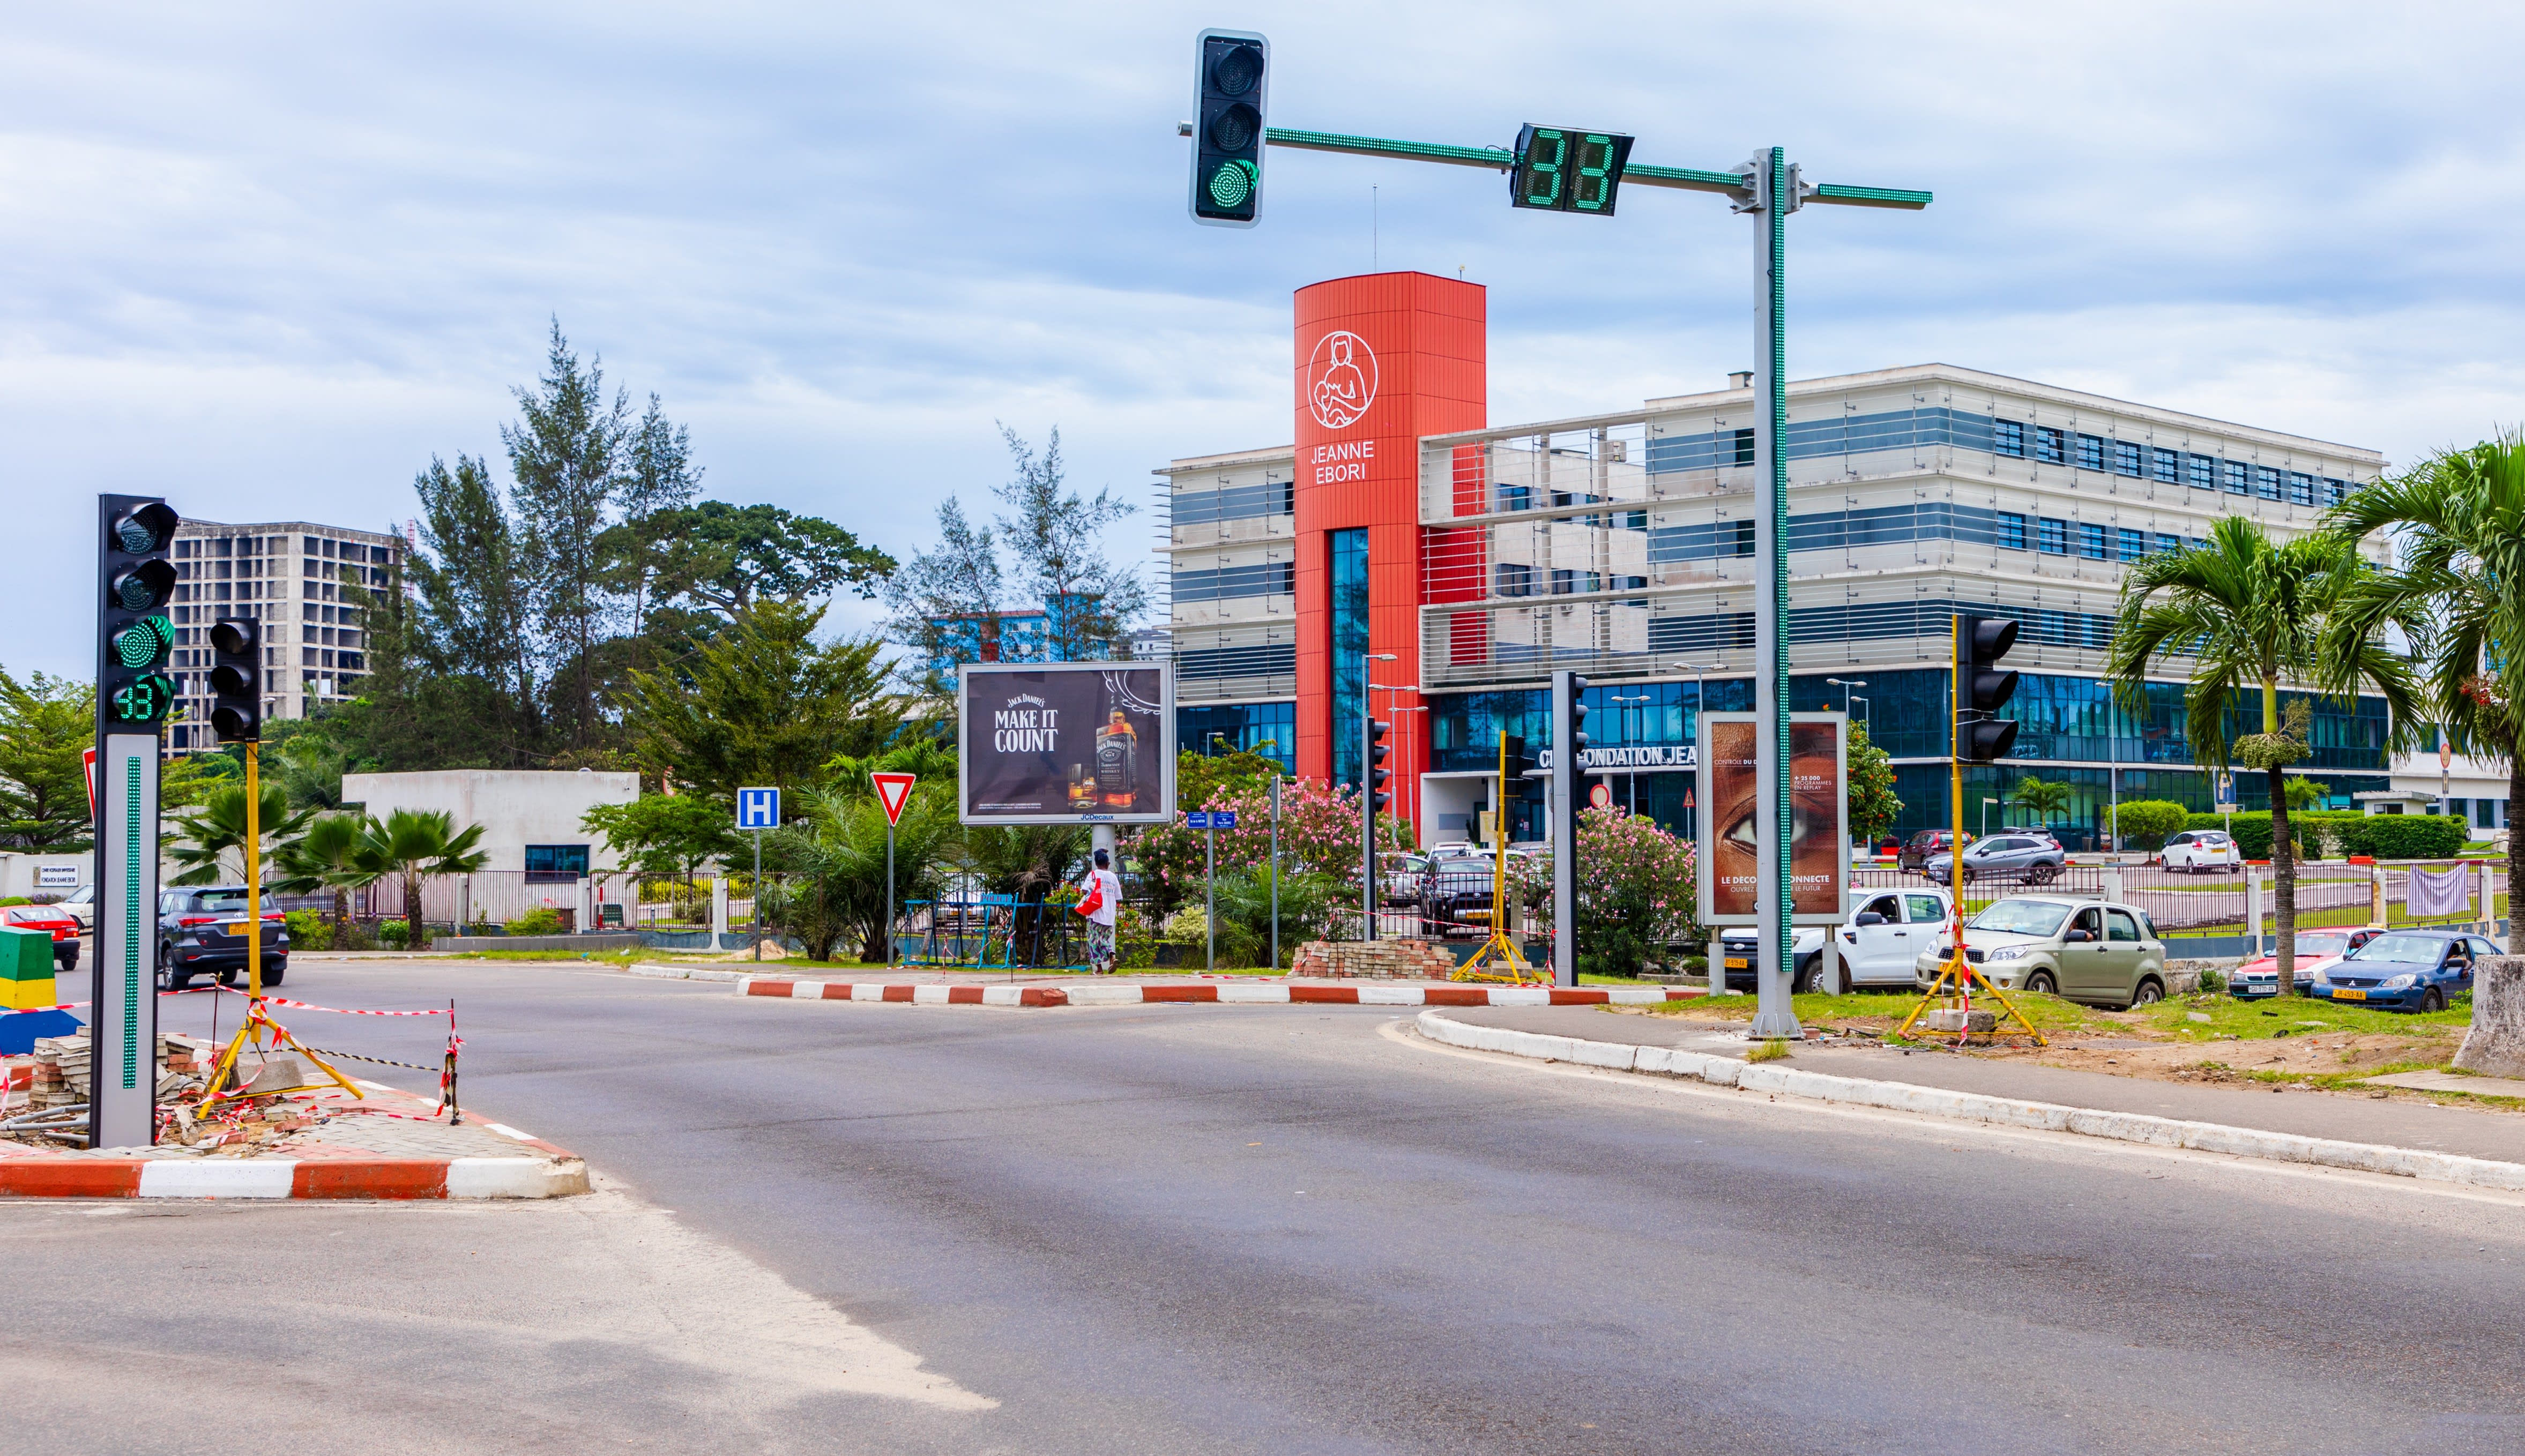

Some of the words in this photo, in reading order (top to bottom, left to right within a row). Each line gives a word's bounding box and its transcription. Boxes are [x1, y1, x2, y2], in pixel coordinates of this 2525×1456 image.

[1528, 129, 1613, 210] 33
[1311, 440, 1374, 465] JEANNE
[1316, 462, 1365, 484] EBORI
[118, 684, 152, 719] 33
[1008, 696, 1022, 708] JACK
[995, 710, 1038, 729] MAKE
[1042, 710, 1058, 728] IT
[995, 729, 1059, 752] COUNT
[1097, 742, 1107, 753] JACK
[1666, 745, 1697, 764] JEA
[747, 792, 771, 825] H
[980, 894, 1011, 903] POLICE
[2336, 990, 2363, 999] JR-453-AA
